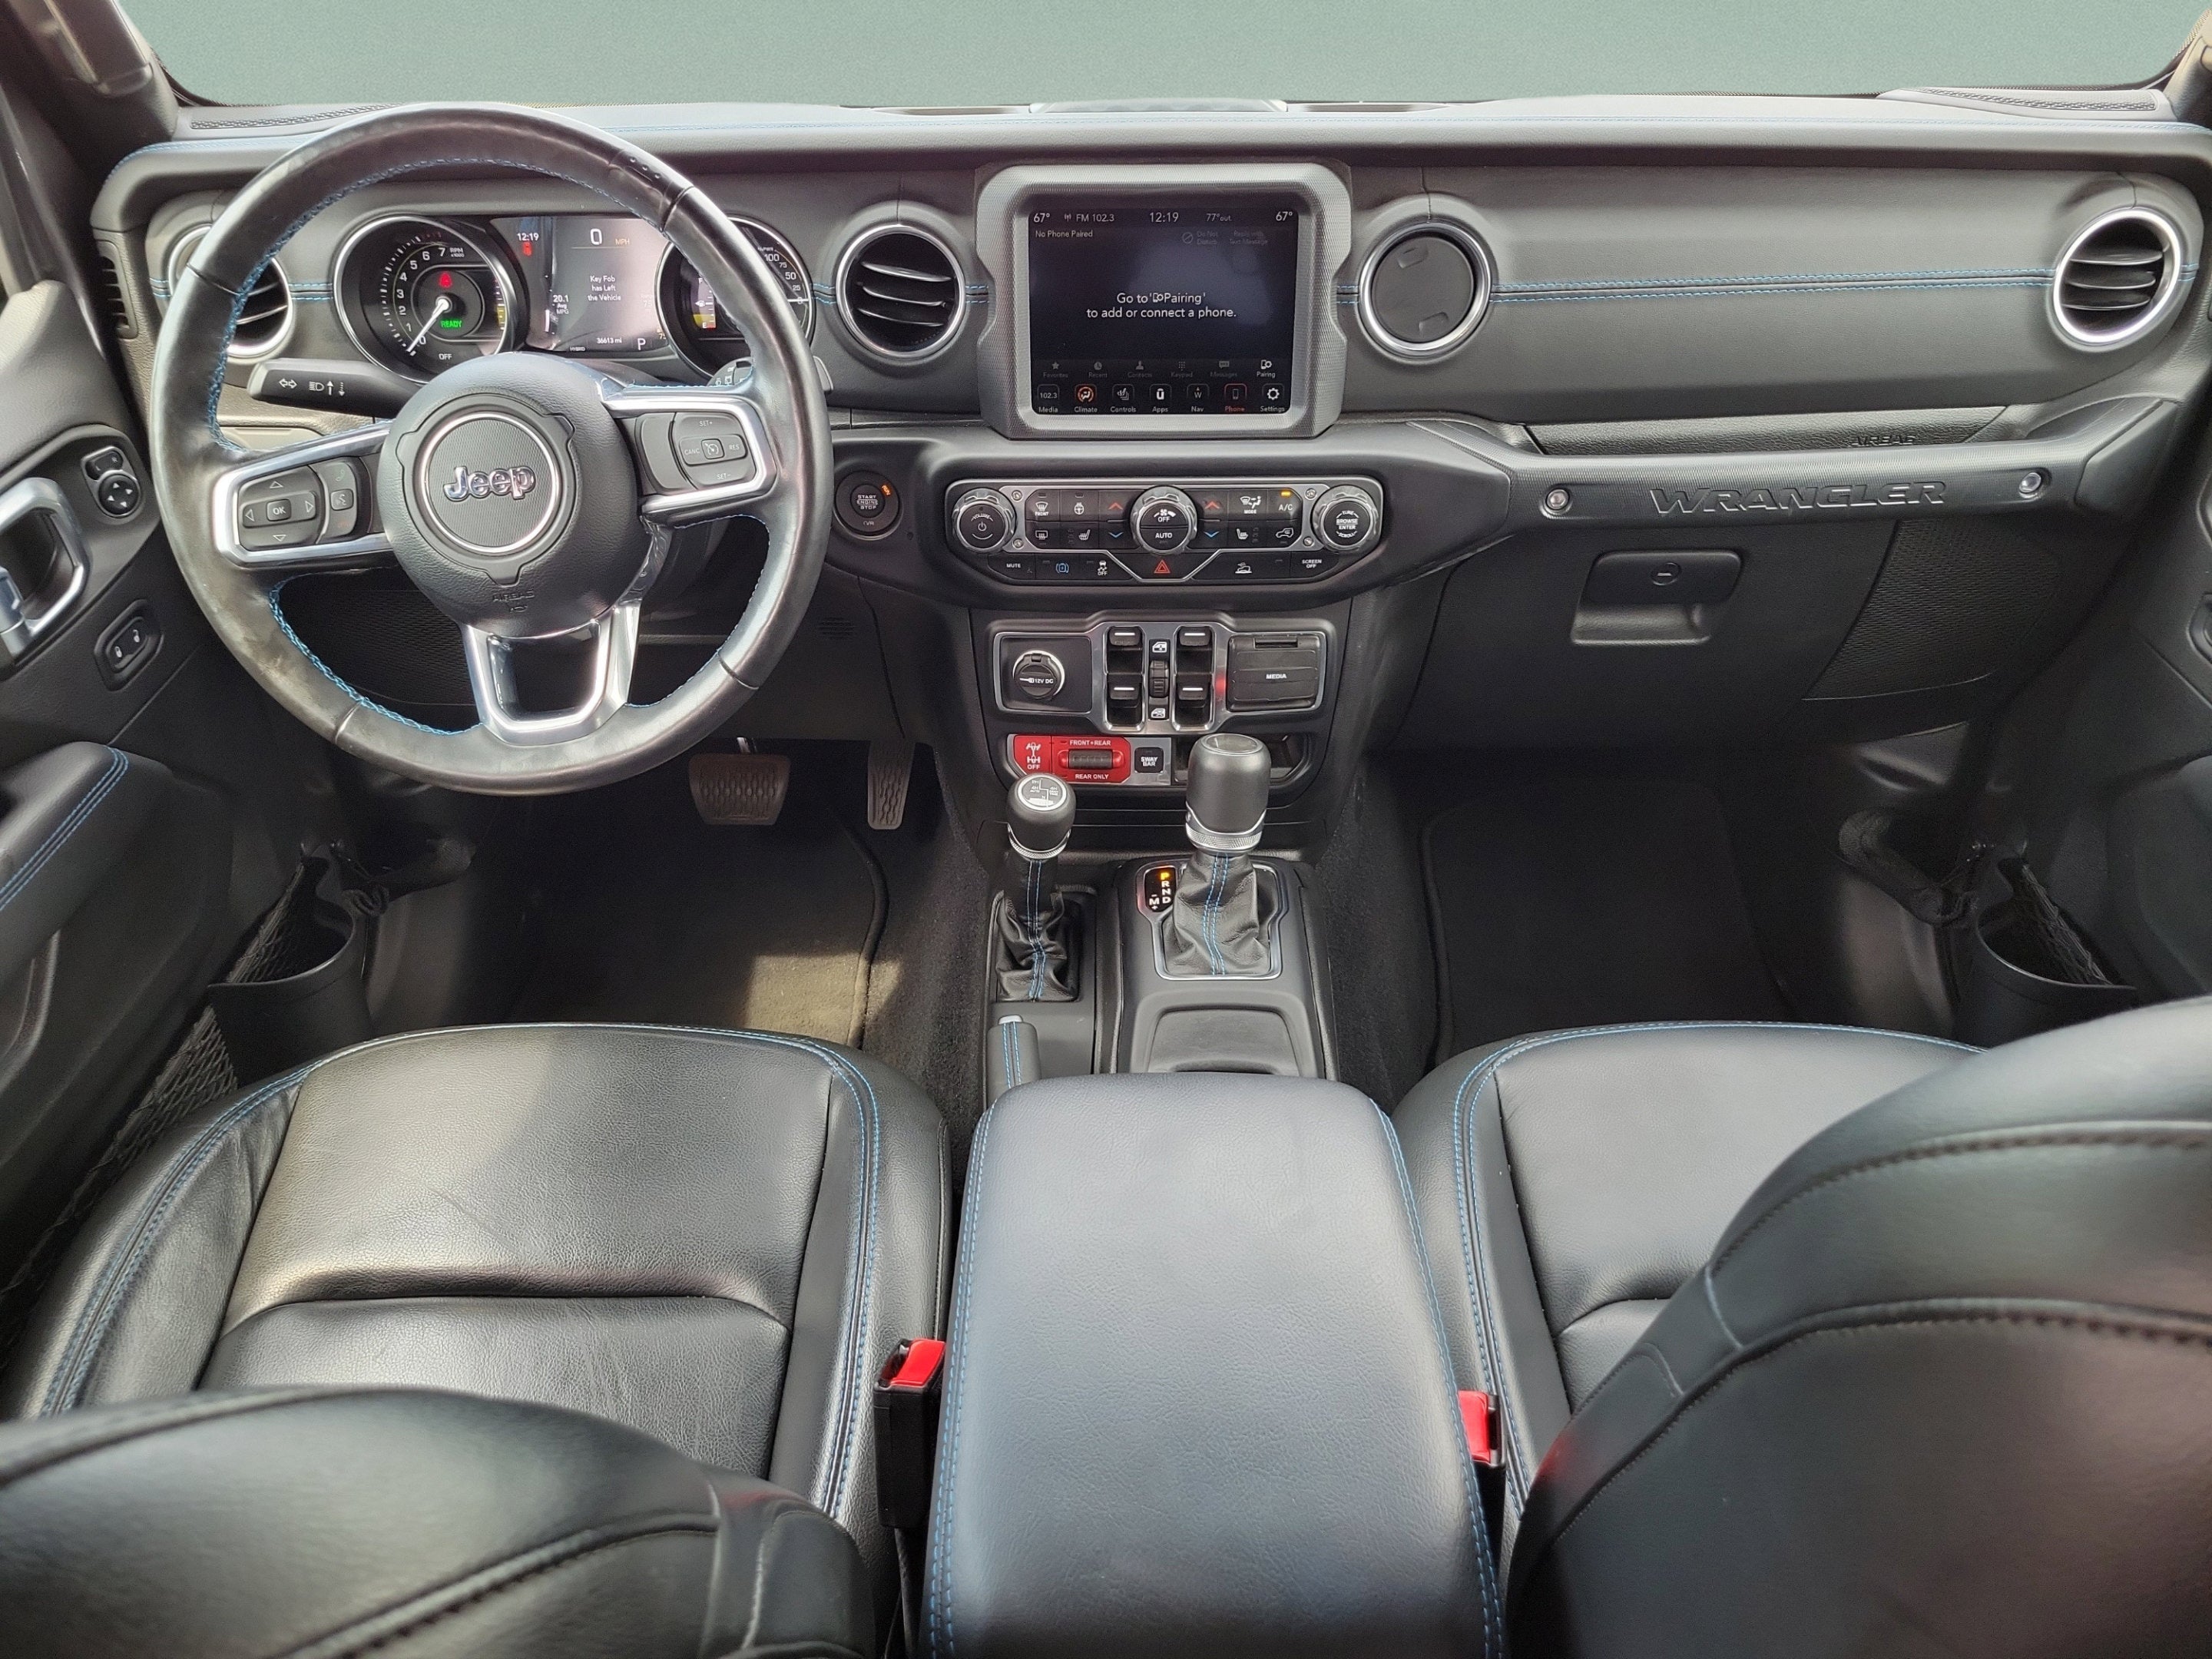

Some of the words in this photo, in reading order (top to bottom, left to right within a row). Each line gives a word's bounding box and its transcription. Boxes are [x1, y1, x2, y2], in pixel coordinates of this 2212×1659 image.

[1033, 212, 1051, 223] 67°
[1076, 214, 1089, 222] FM
[1091, 214, 1114, 222] 102.3
[1149, 212, 1179, 223] 12:19
[1275, 211, 1293, 221] 67°
[517, 233, 539, 241] 12:19
[590, 228, 602, 245] 0
[422, 250, 430, 261] 6
[439, 247, 445, 257] 7
[764, 253, 780, 262] 100
[409, 261, 418, 271] 5
[399, 272, 408, 282] 4
[590, 275, 601, 285] Key
[603, 275, 616, 283] Fob
[785, 272, 797, 280] 50
[396, 288, 405, 299] 3
[553, 294, 570, 303] 20.1
[588, 294, 599, 303] the
[600, 294, 621, 303] Vehicle
[1116, 293, 1134, 304] Go
[1136, 293, 1149, 304] to
[398, 306, 406, 316] 2
[1086, 308, 1099, 318] to
[1101, 306, 1123, 318] add
[1125, 310, 1139, 318] or
[1140, 308, 1186, 318] connect
[1187, 310, 1195, 318] a
[1198, 306, 1237, 320] phone.
[440, 319, 462, 329] READY
[637, 338, 647, 351] P
[1257, 371, 1276, 379] Pairing
[1040, 391, 1058, 399] 102.3
[1038, 406, 1058, 414] Media
[1152, 406, 1169, 415] Apps
[1260, 406, 1286, 416] Settings
[443, 465, 537, 502] Jeep
[1649, 481, 1947, 515] WRANGLER
[273, 506, 287, 516] OK
[1278, 503, 1294, 512] A/C
[1154, 531, 1174, 539] AUTO
[1161, 872, 1171, 881] P
[1149, 897, 1160, 906] M
[1162, 896, 1171, 904] D
